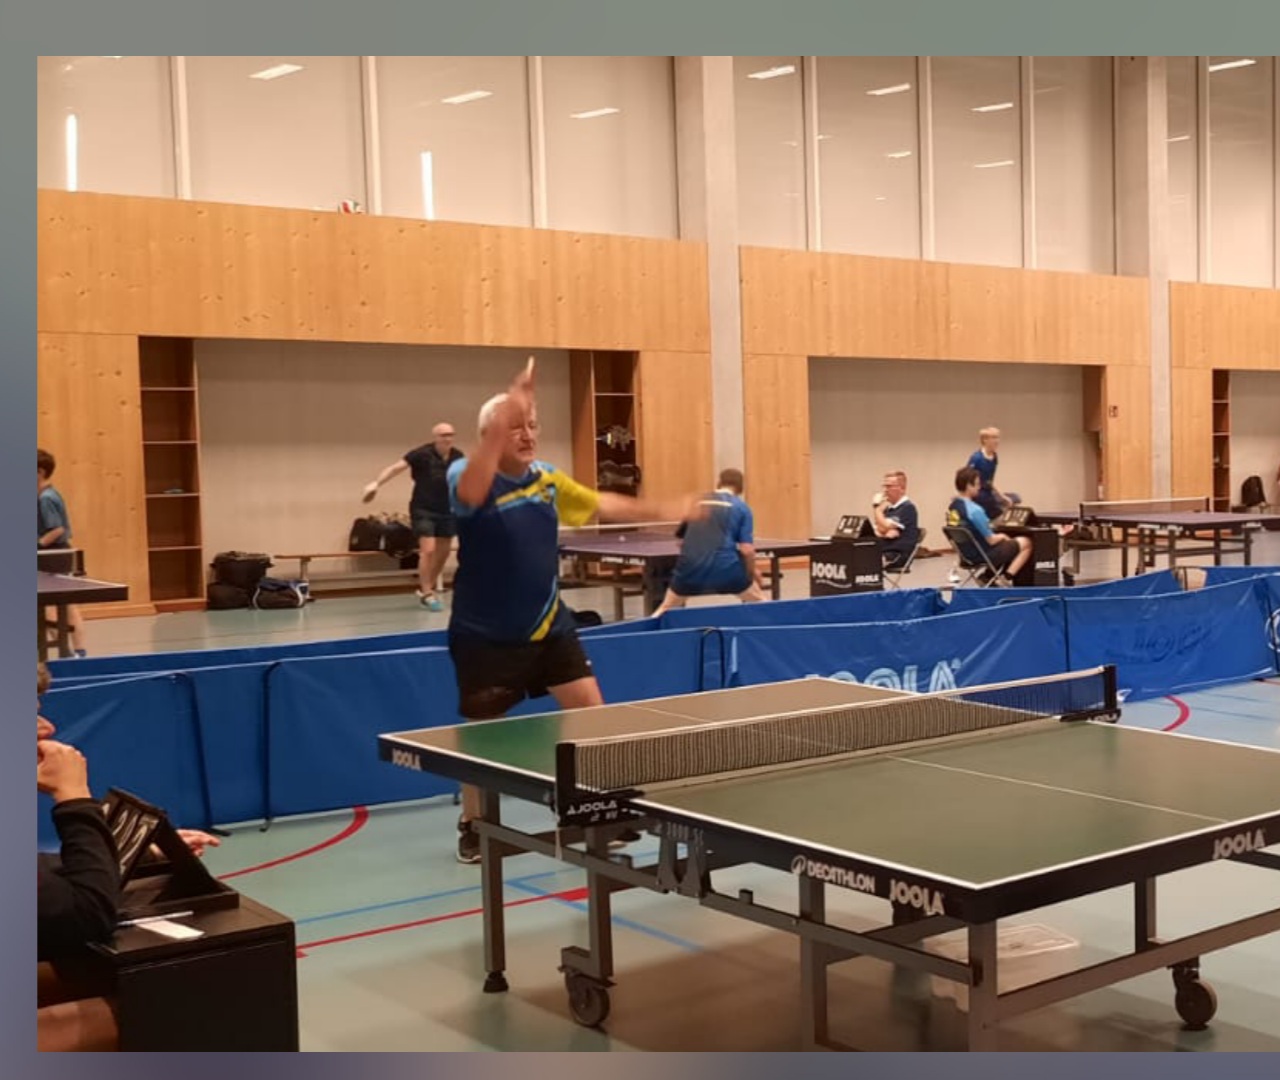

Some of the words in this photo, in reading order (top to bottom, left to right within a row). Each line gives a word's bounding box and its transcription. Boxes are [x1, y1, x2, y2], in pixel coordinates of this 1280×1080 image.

[812, 562, 847, 580] JOOLA
[392, 750, 421, 770] JOOLA
[1212, 829, 1266, 860] JOOLA
[807, 861, 875, 893] DECATHLON
[890, 879, 944, 916] JOOLA
